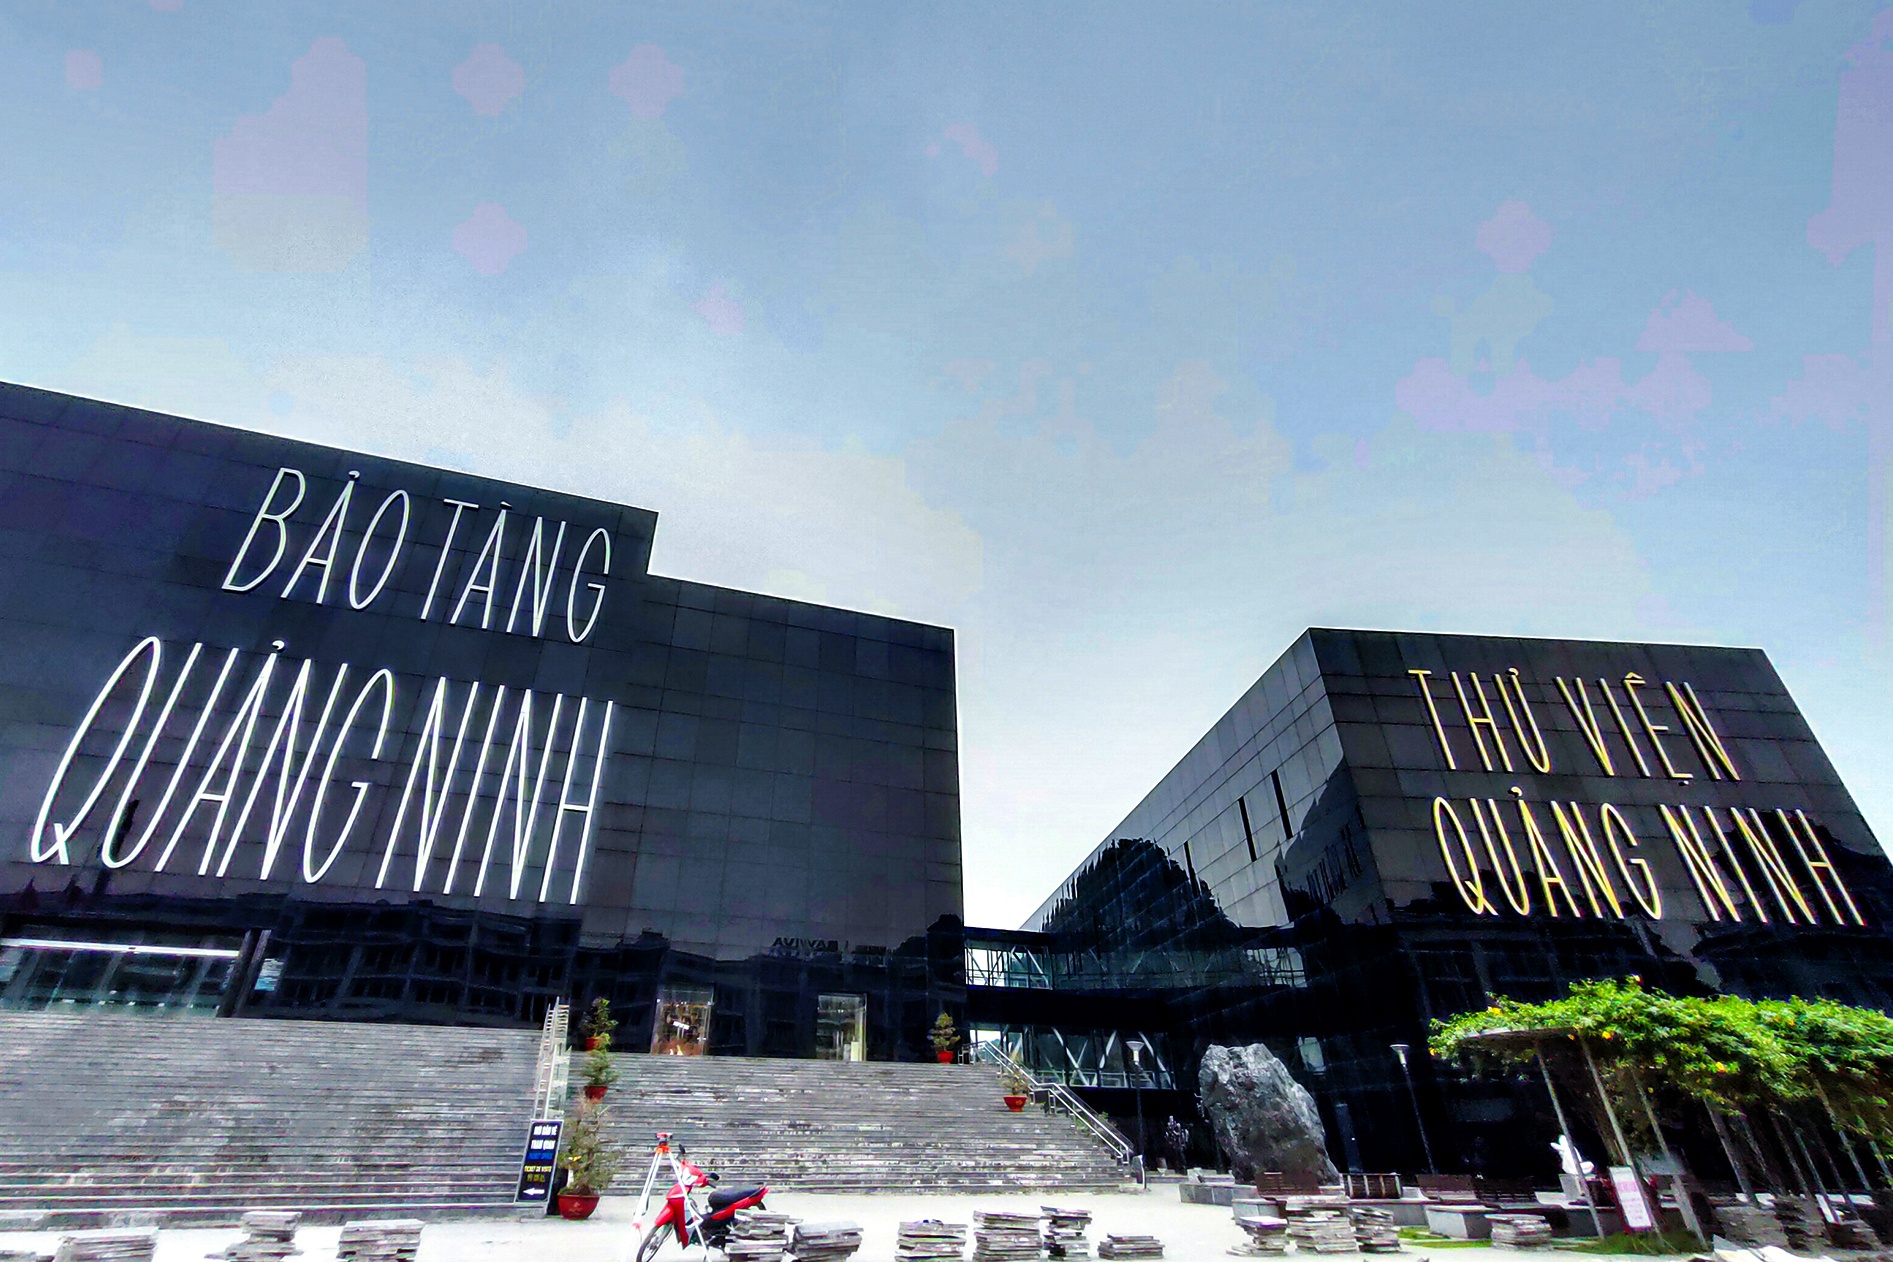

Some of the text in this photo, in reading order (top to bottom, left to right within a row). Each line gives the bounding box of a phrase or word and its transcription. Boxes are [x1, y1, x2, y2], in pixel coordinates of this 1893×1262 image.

[221, 467, 610, 643] BẢO TÀNG
[30, 636, 614, 905] QUẢNG NINH
[1553, 671, 1741, 785] VIỆN
[1433, 785, 1867, 926] QUẢNG NINH
